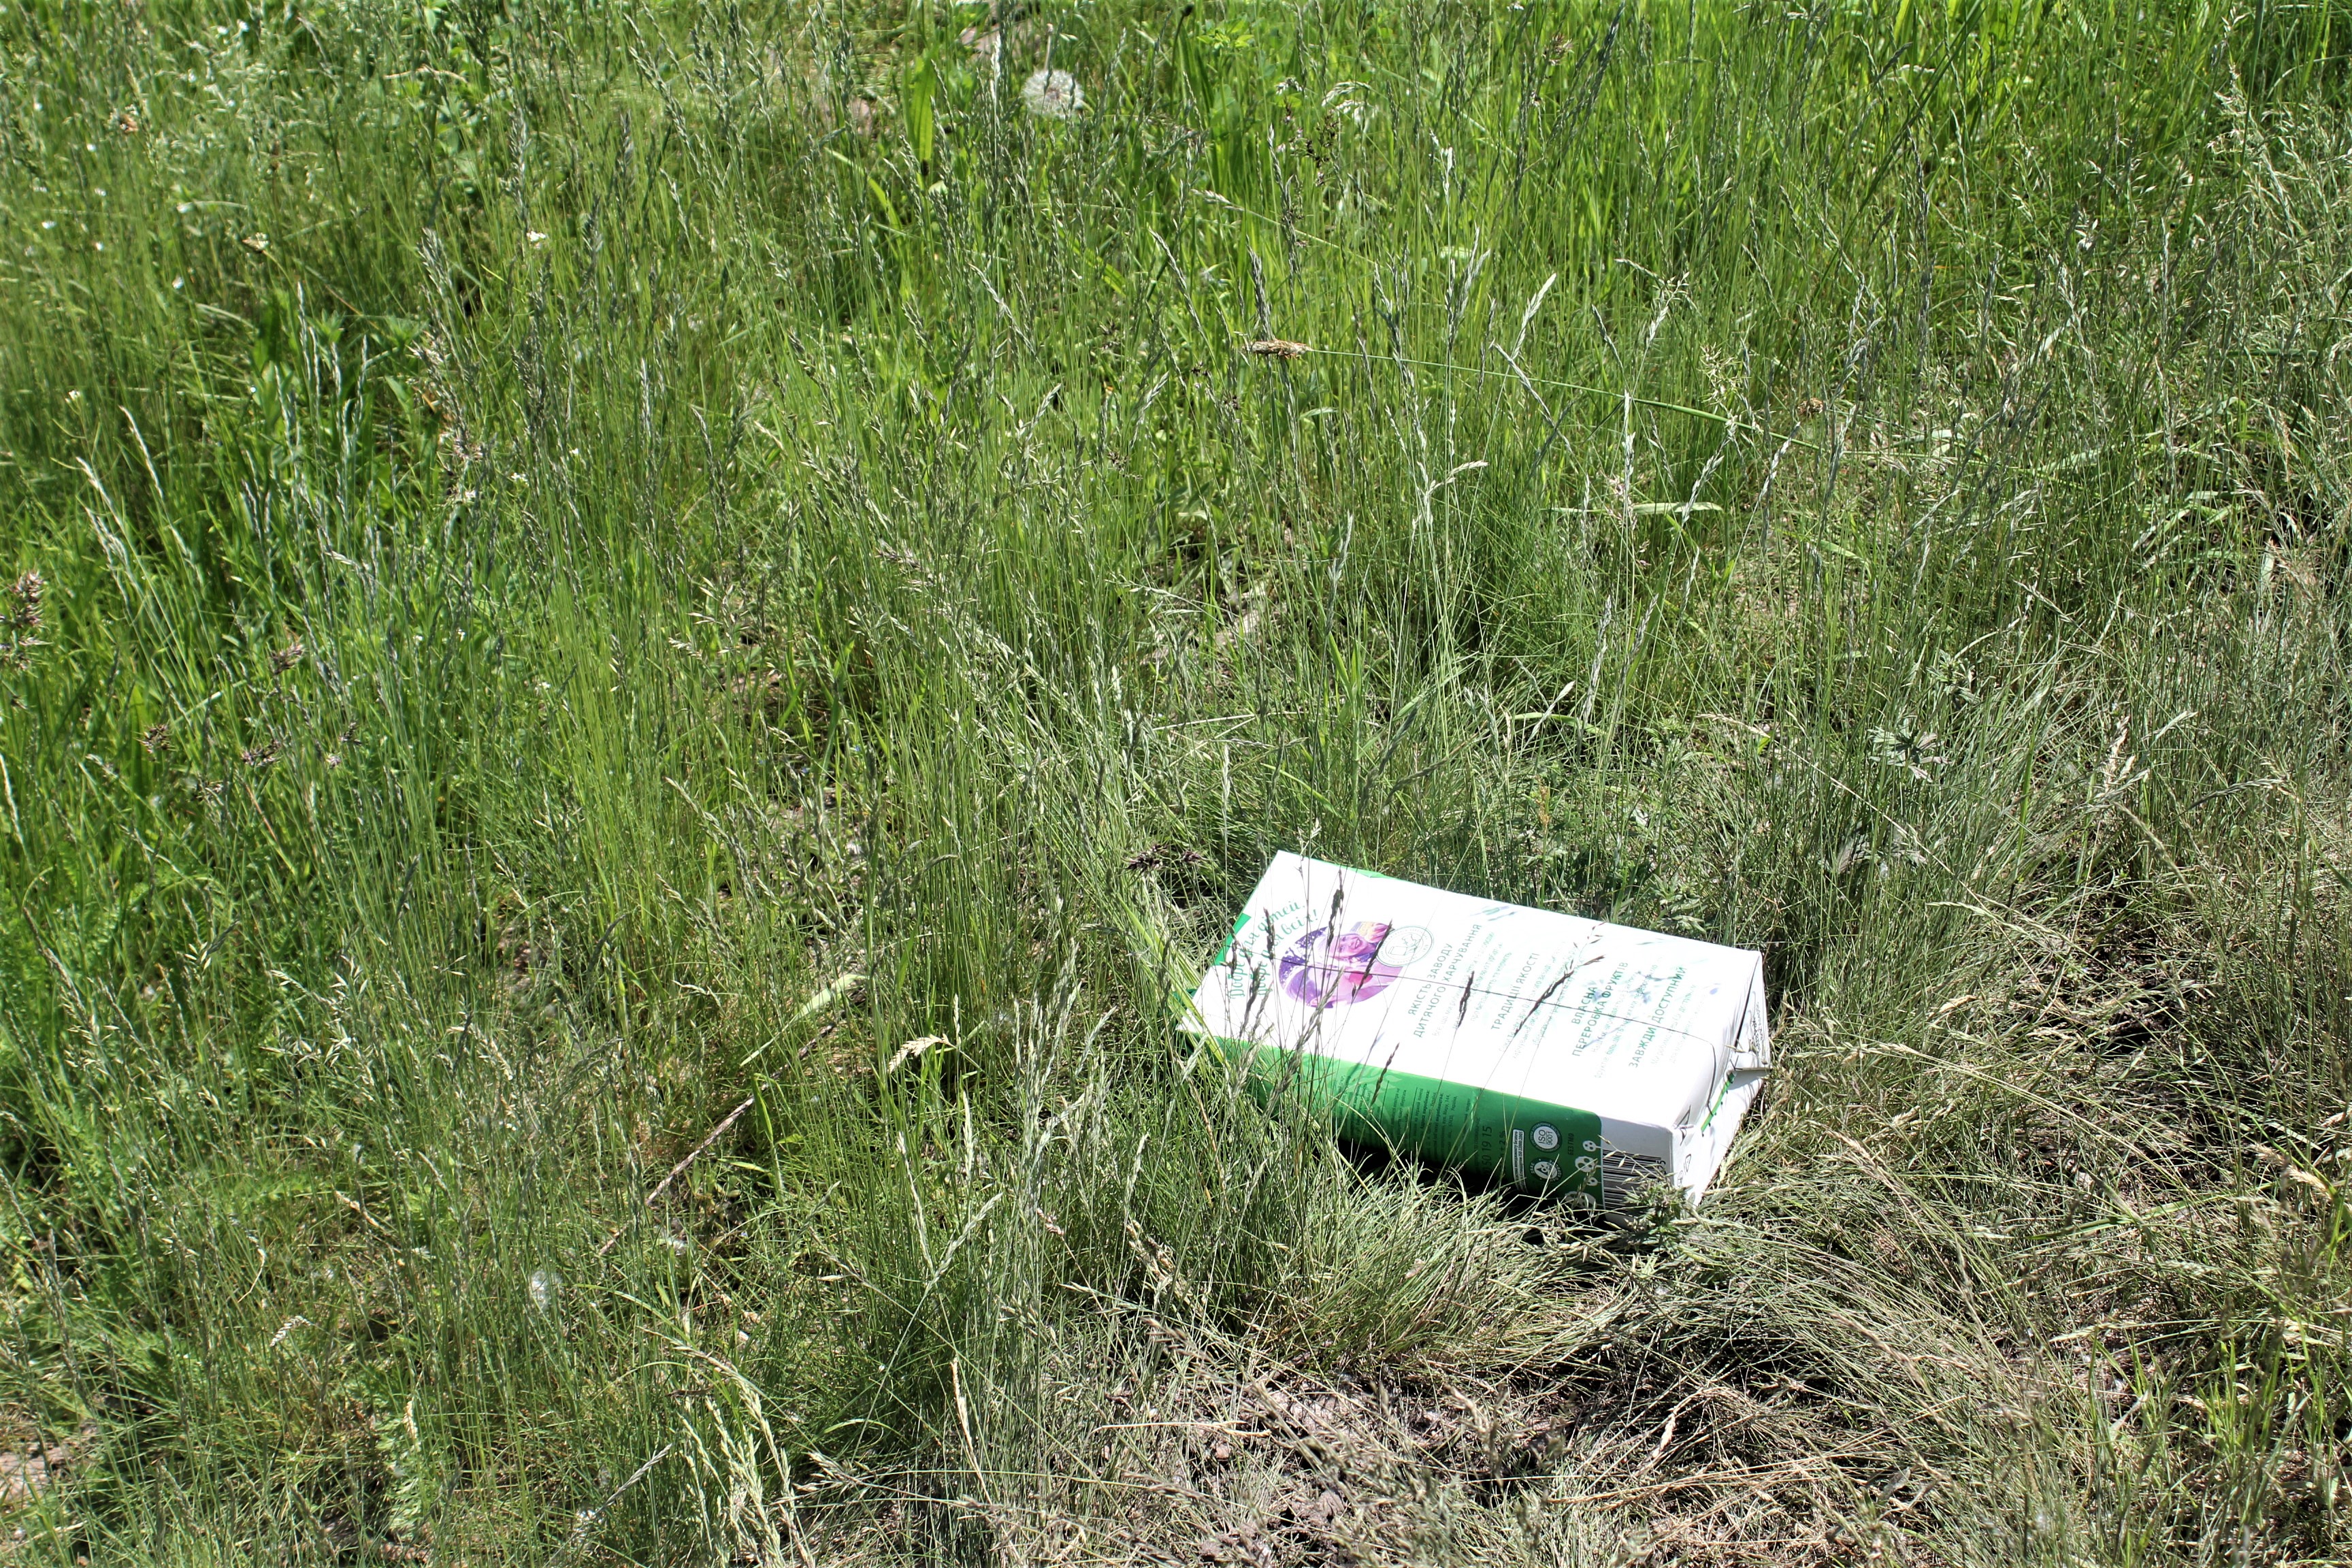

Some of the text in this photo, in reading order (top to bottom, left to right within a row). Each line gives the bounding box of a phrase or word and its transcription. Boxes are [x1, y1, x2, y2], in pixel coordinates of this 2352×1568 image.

[1407, 943, 1452, 1015] ЯКІСТЬ ЗАВОДУ
[1413, 985, 1446, 1038] ДИТЯЧОГО
[1441, 924, 1482, 982] ХАРЧУВАННЯ
[1490, 952, 1539, 1029] ТРАДИЦІЇ ЯКОСТІ
[1571, 986, 1598, 1024] ВЛАСНА
[1571, 1000, 1607, 1056] ПЕРЕРОБКА
[1599, 962, 1628, 998] ФРУКТІВ
[1628, 966, 1686, 1068] ЗАВЖДИ ДОСТУПНИЙ
[1482, 1141, 1492, 1152] 19
[1484, 1126, 1492, 1137] 15
